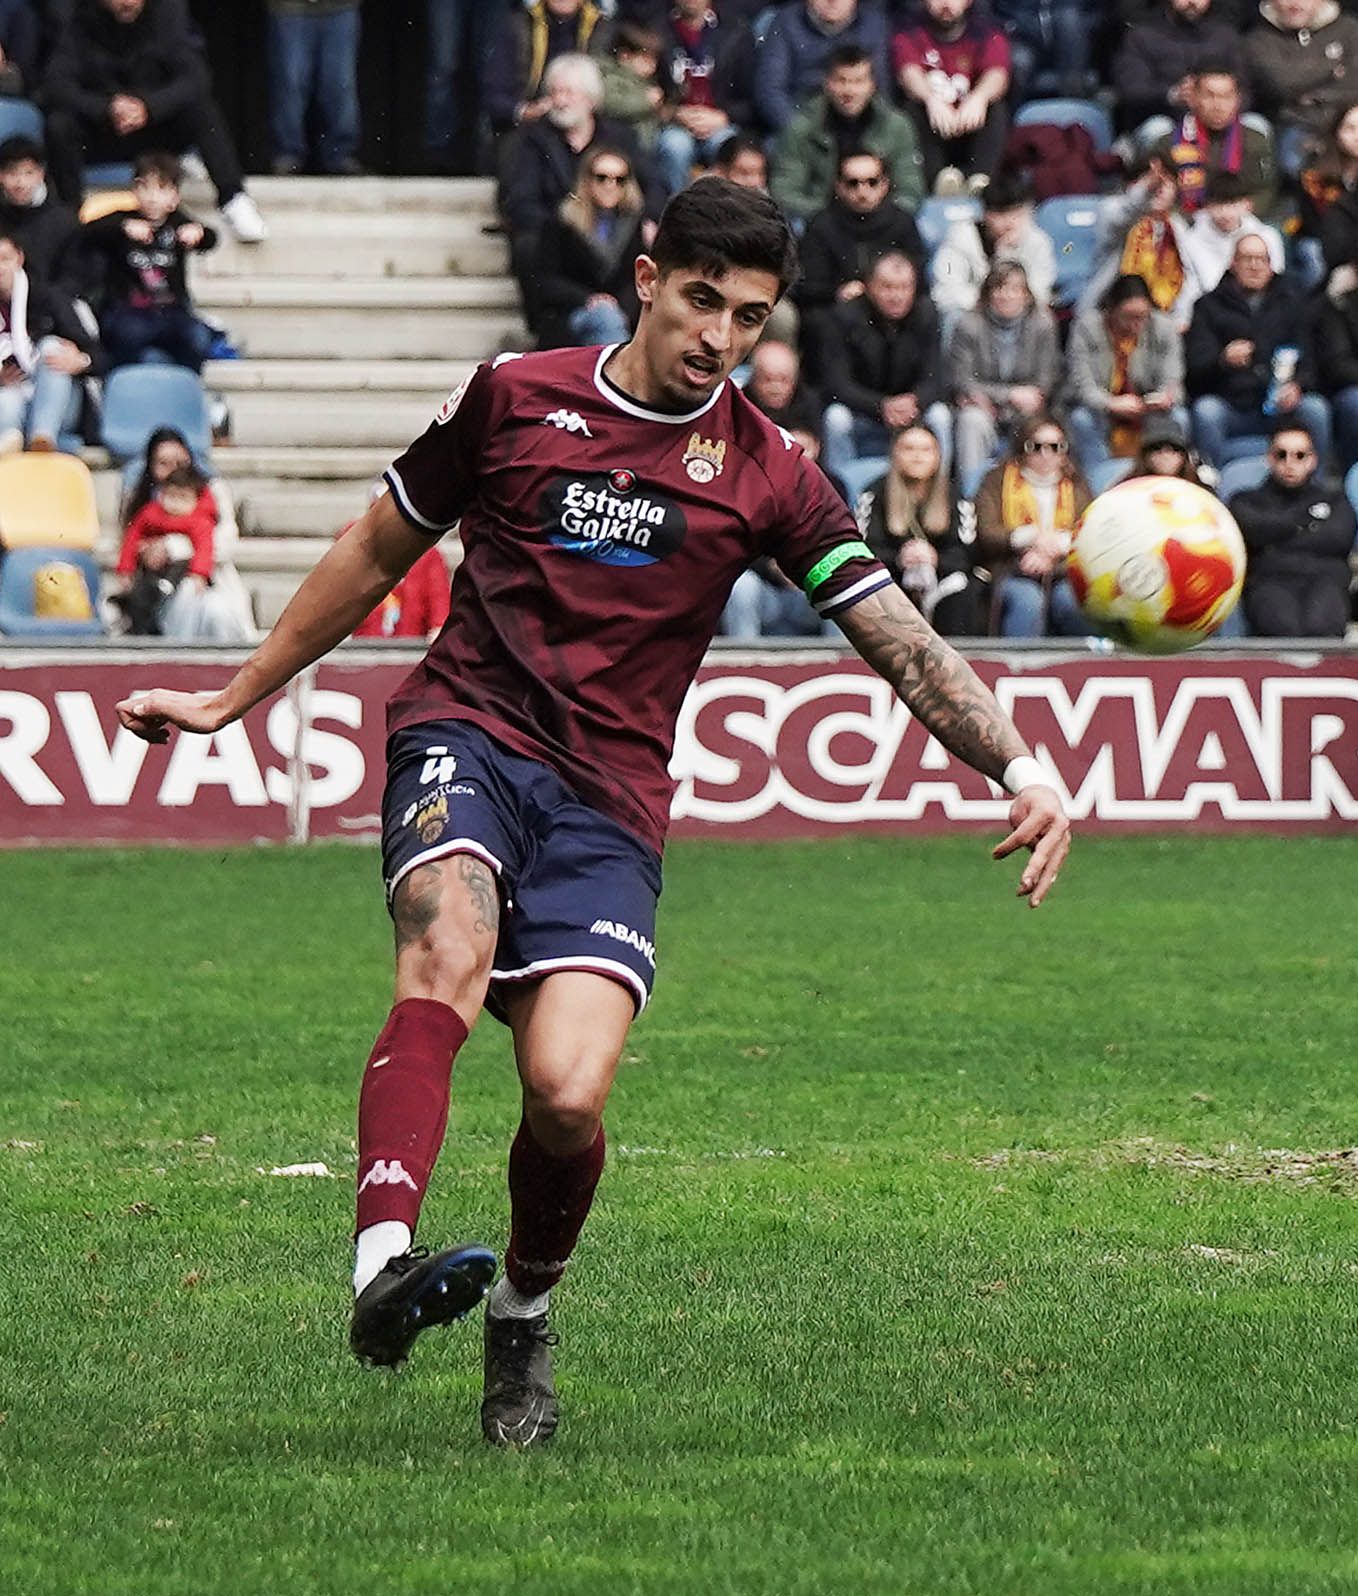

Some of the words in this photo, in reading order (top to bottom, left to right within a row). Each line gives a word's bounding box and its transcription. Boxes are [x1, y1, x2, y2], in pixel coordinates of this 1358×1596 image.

[561, 482, 667, 526] Estrella
[560, 507, 652, 547] Galicia
[0, 689, 366, 808] RVAS
